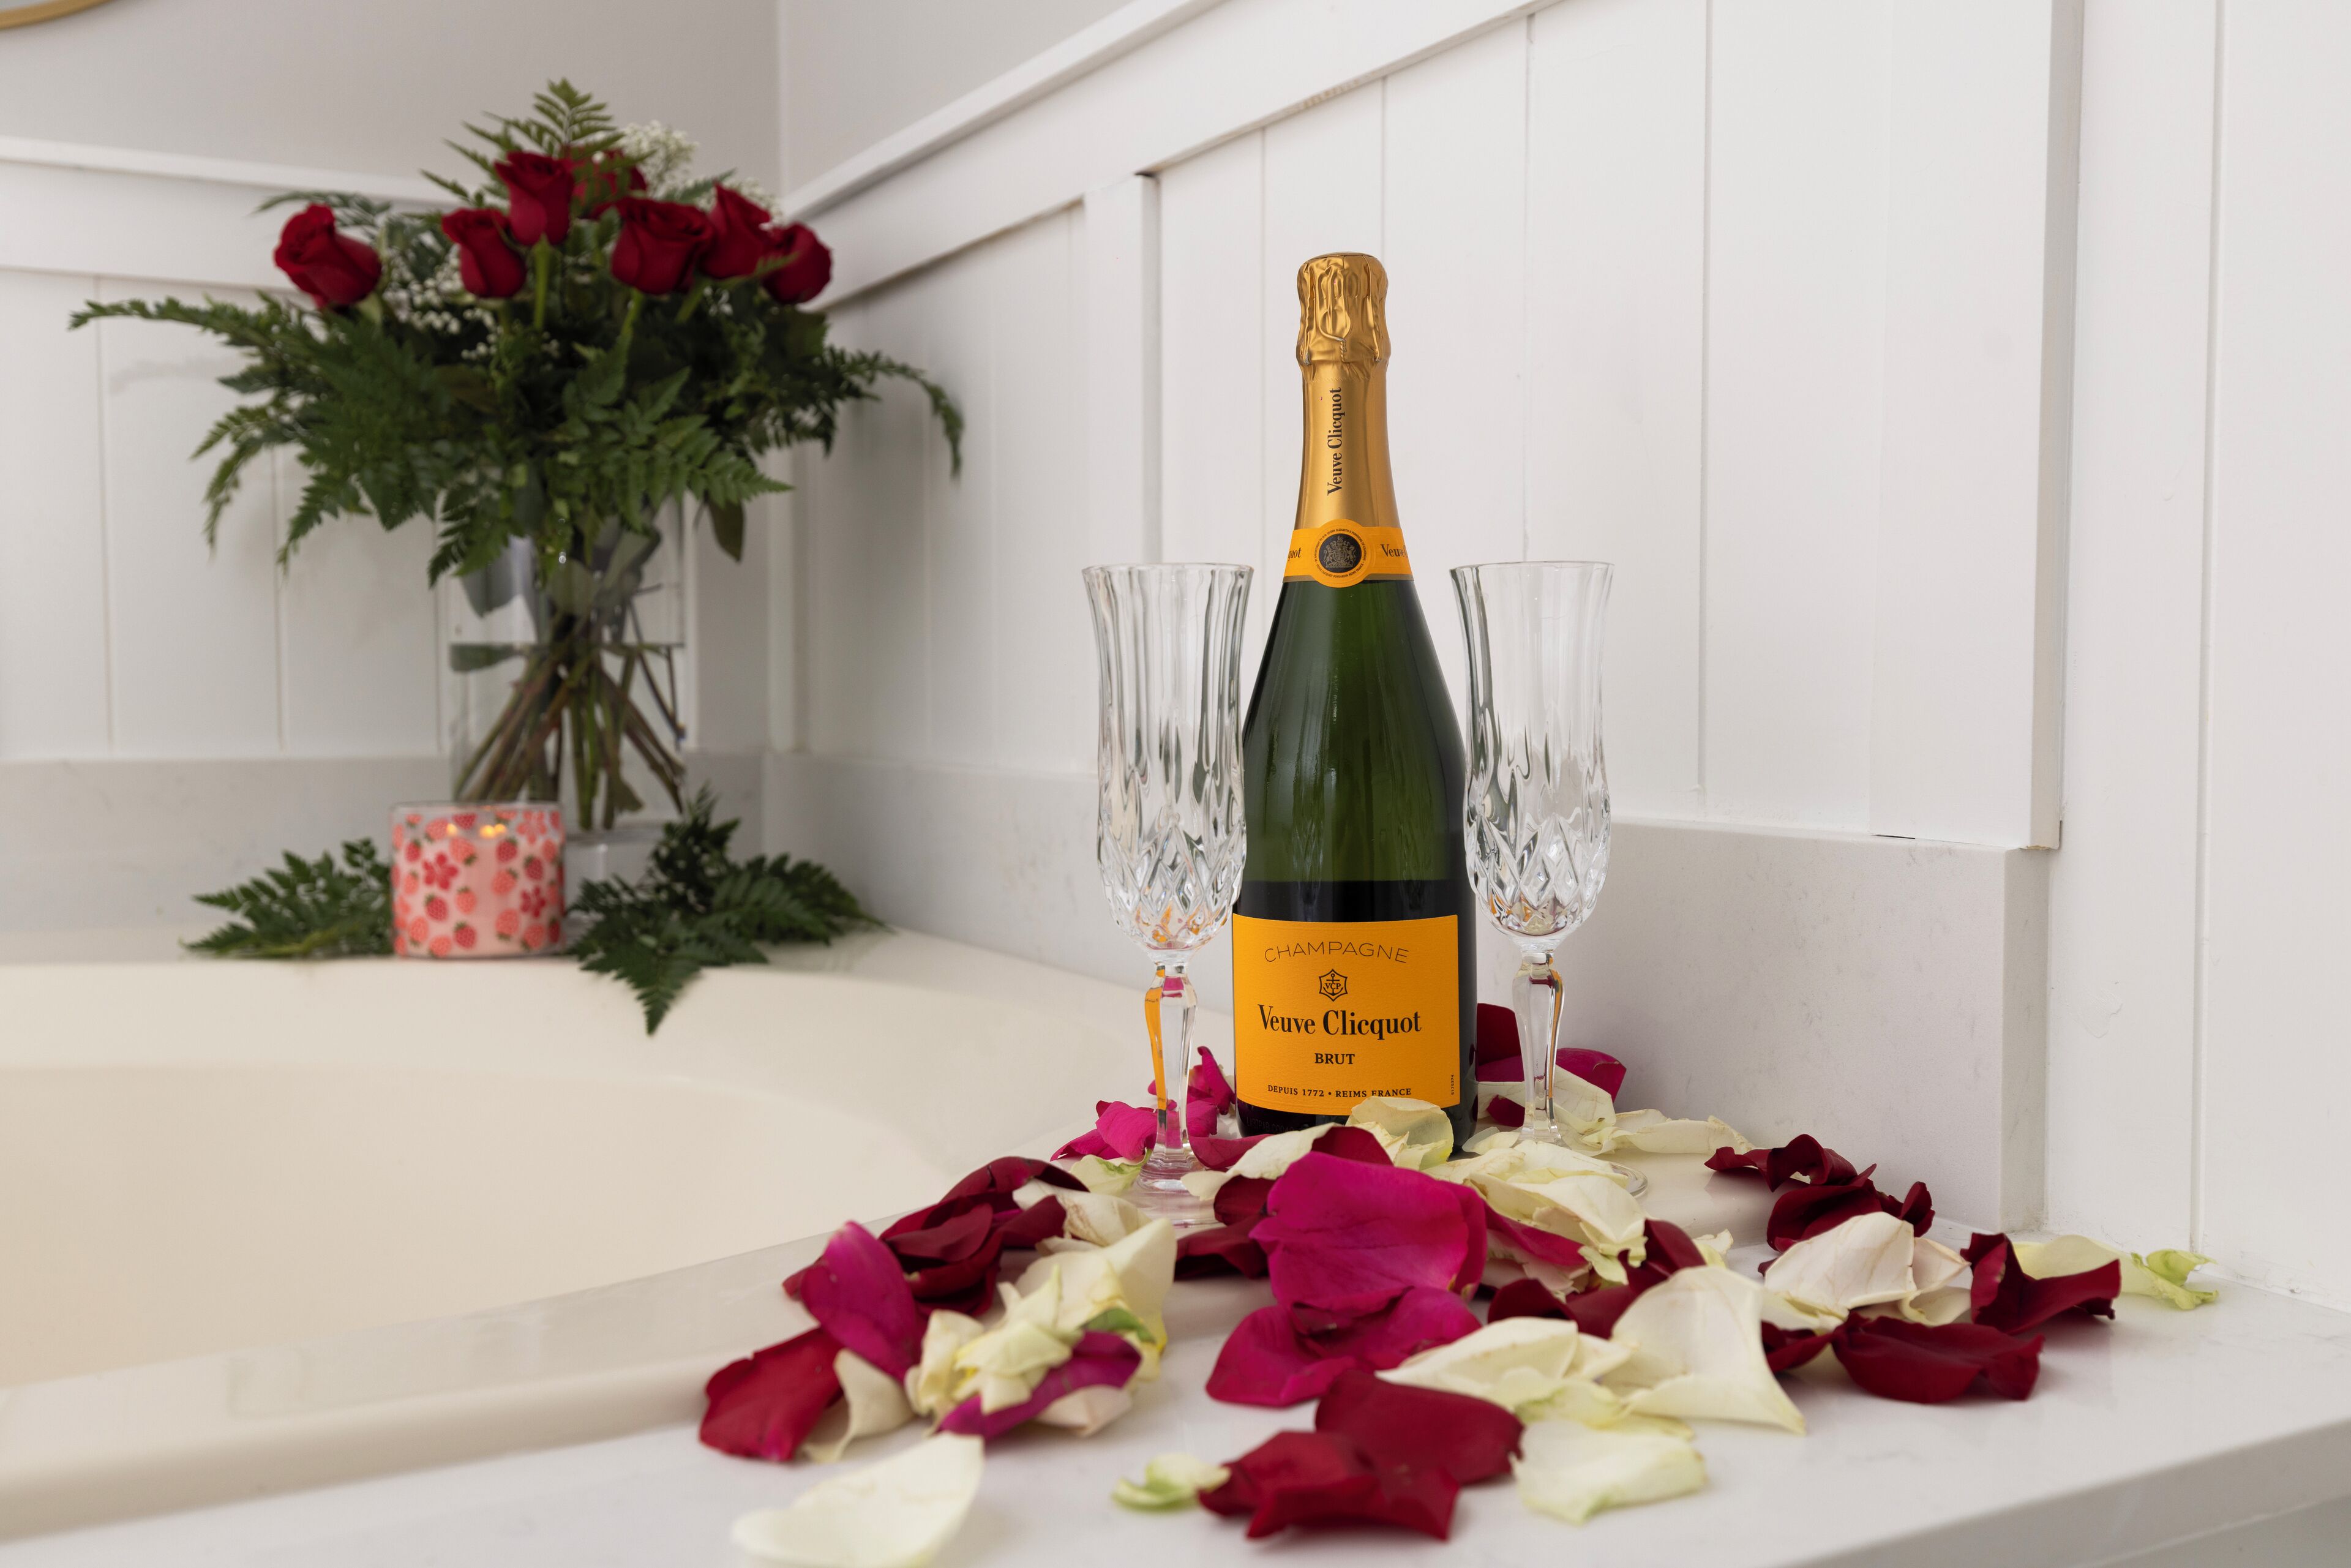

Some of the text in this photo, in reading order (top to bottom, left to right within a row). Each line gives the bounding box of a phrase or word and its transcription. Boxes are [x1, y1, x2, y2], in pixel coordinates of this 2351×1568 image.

[1327, 386, 1346, 496] Veuve Clicquot
[1264, 941, 1409, 964] CHAMPAGNE
[1257, 1003, 1422, 1040] Veuve Clicquot
[1314, 1052, 1355, 1065] BRUT
[1267, 1084, 1298, 1095] DEPUIS
[1302, 1089, 1324, 1097] 1772
[1371, 1088, 1411, 1097] FRANCE
